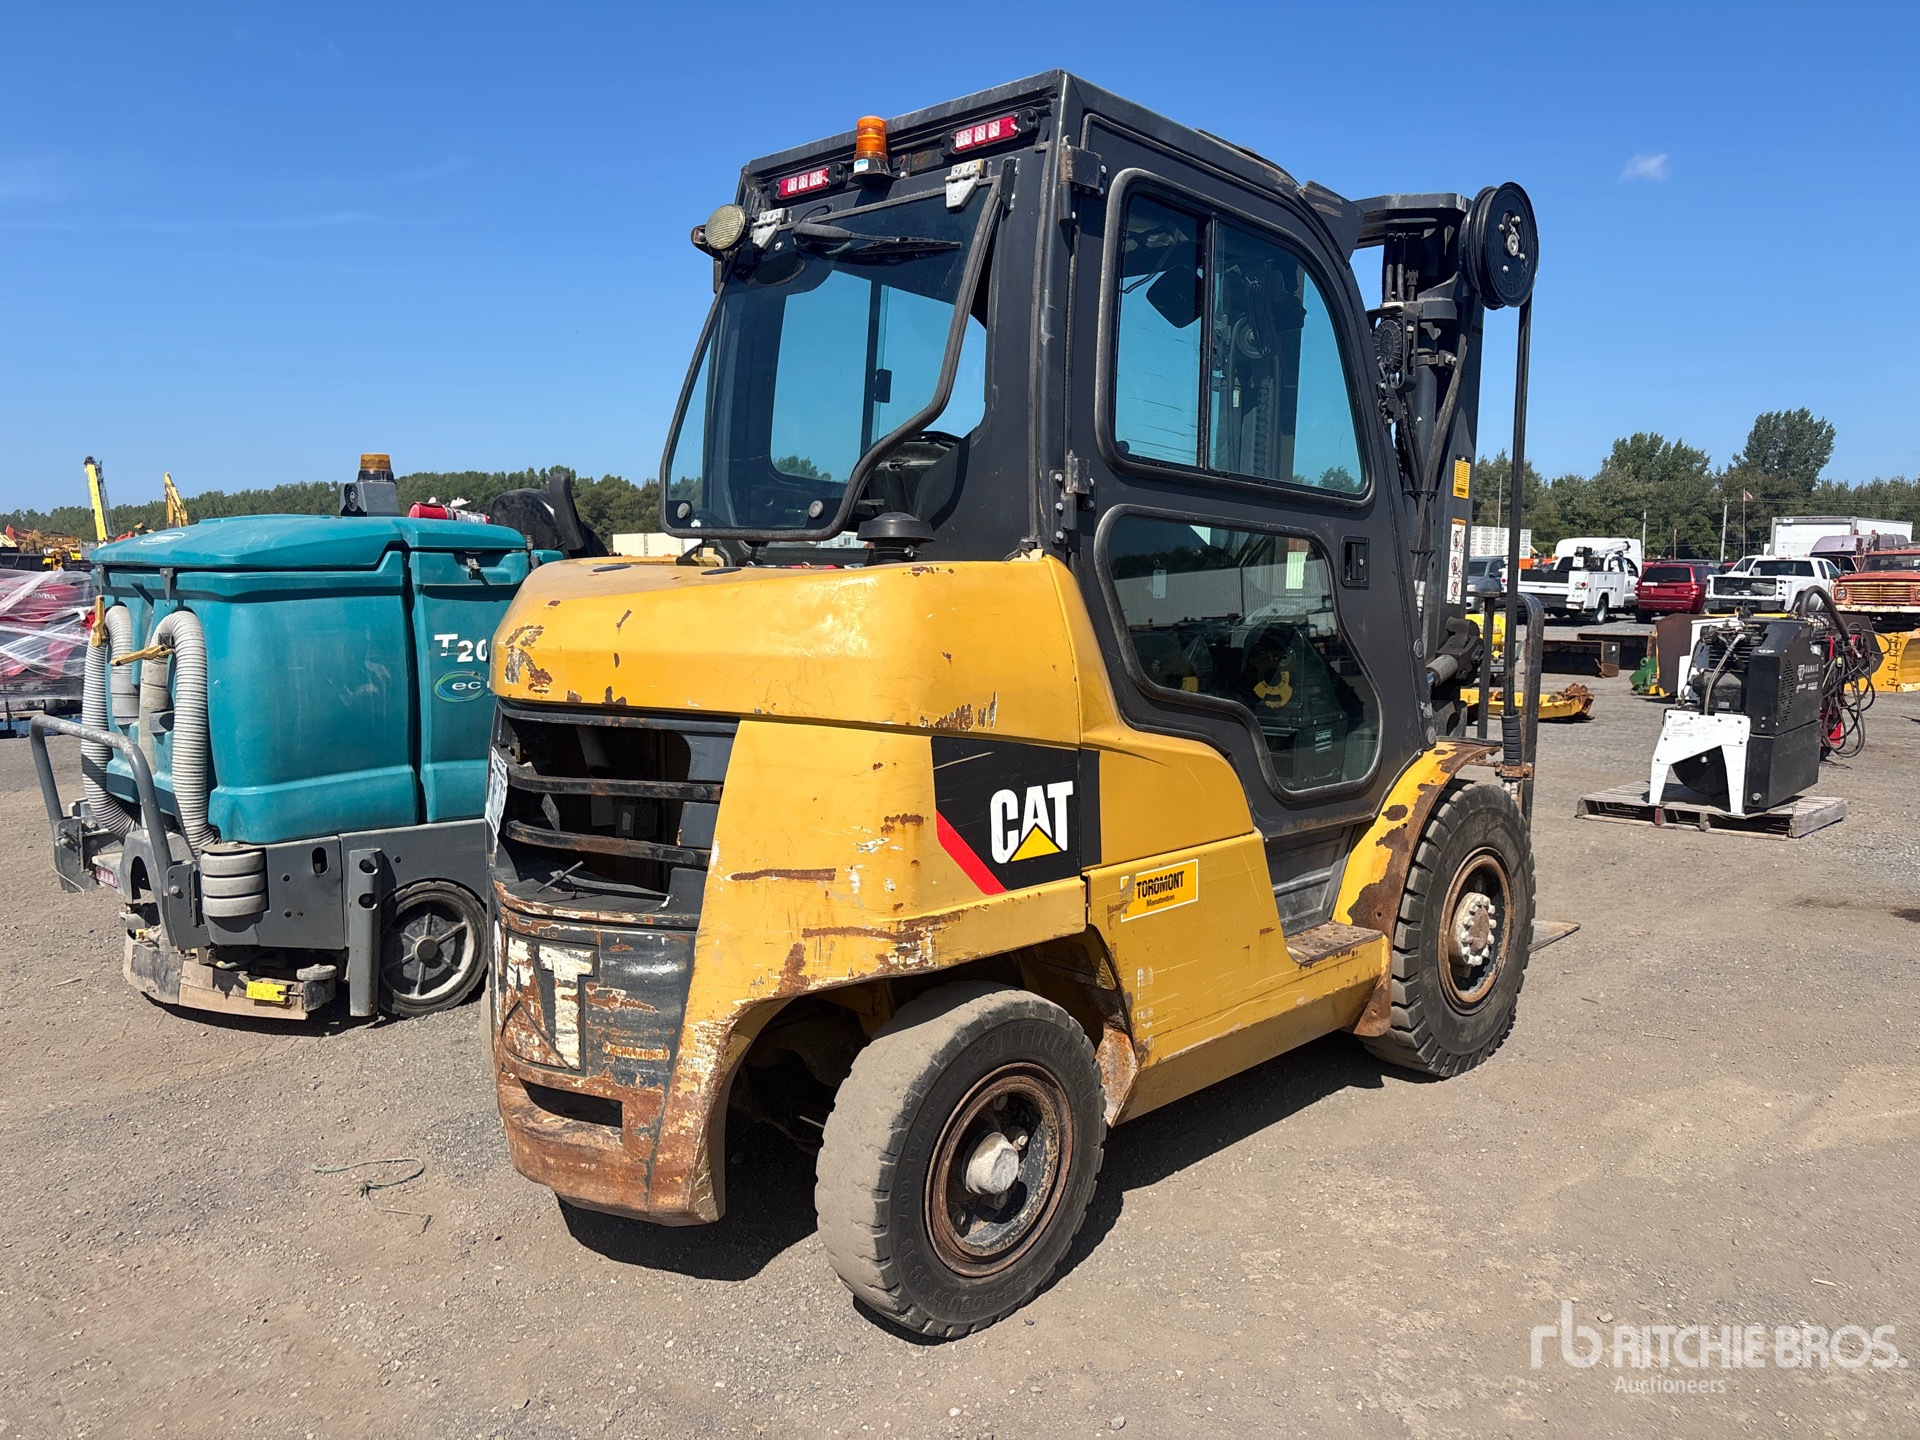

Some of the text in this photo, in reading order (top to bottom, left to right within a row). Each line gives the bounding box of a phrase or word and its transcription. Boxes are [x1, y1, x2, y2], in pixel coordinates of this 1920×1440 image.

[434, 634, 487, 662] T20
[990, 780, 1074, 864] CAT
[1136, 871, 1185, 899] TOROMONT
